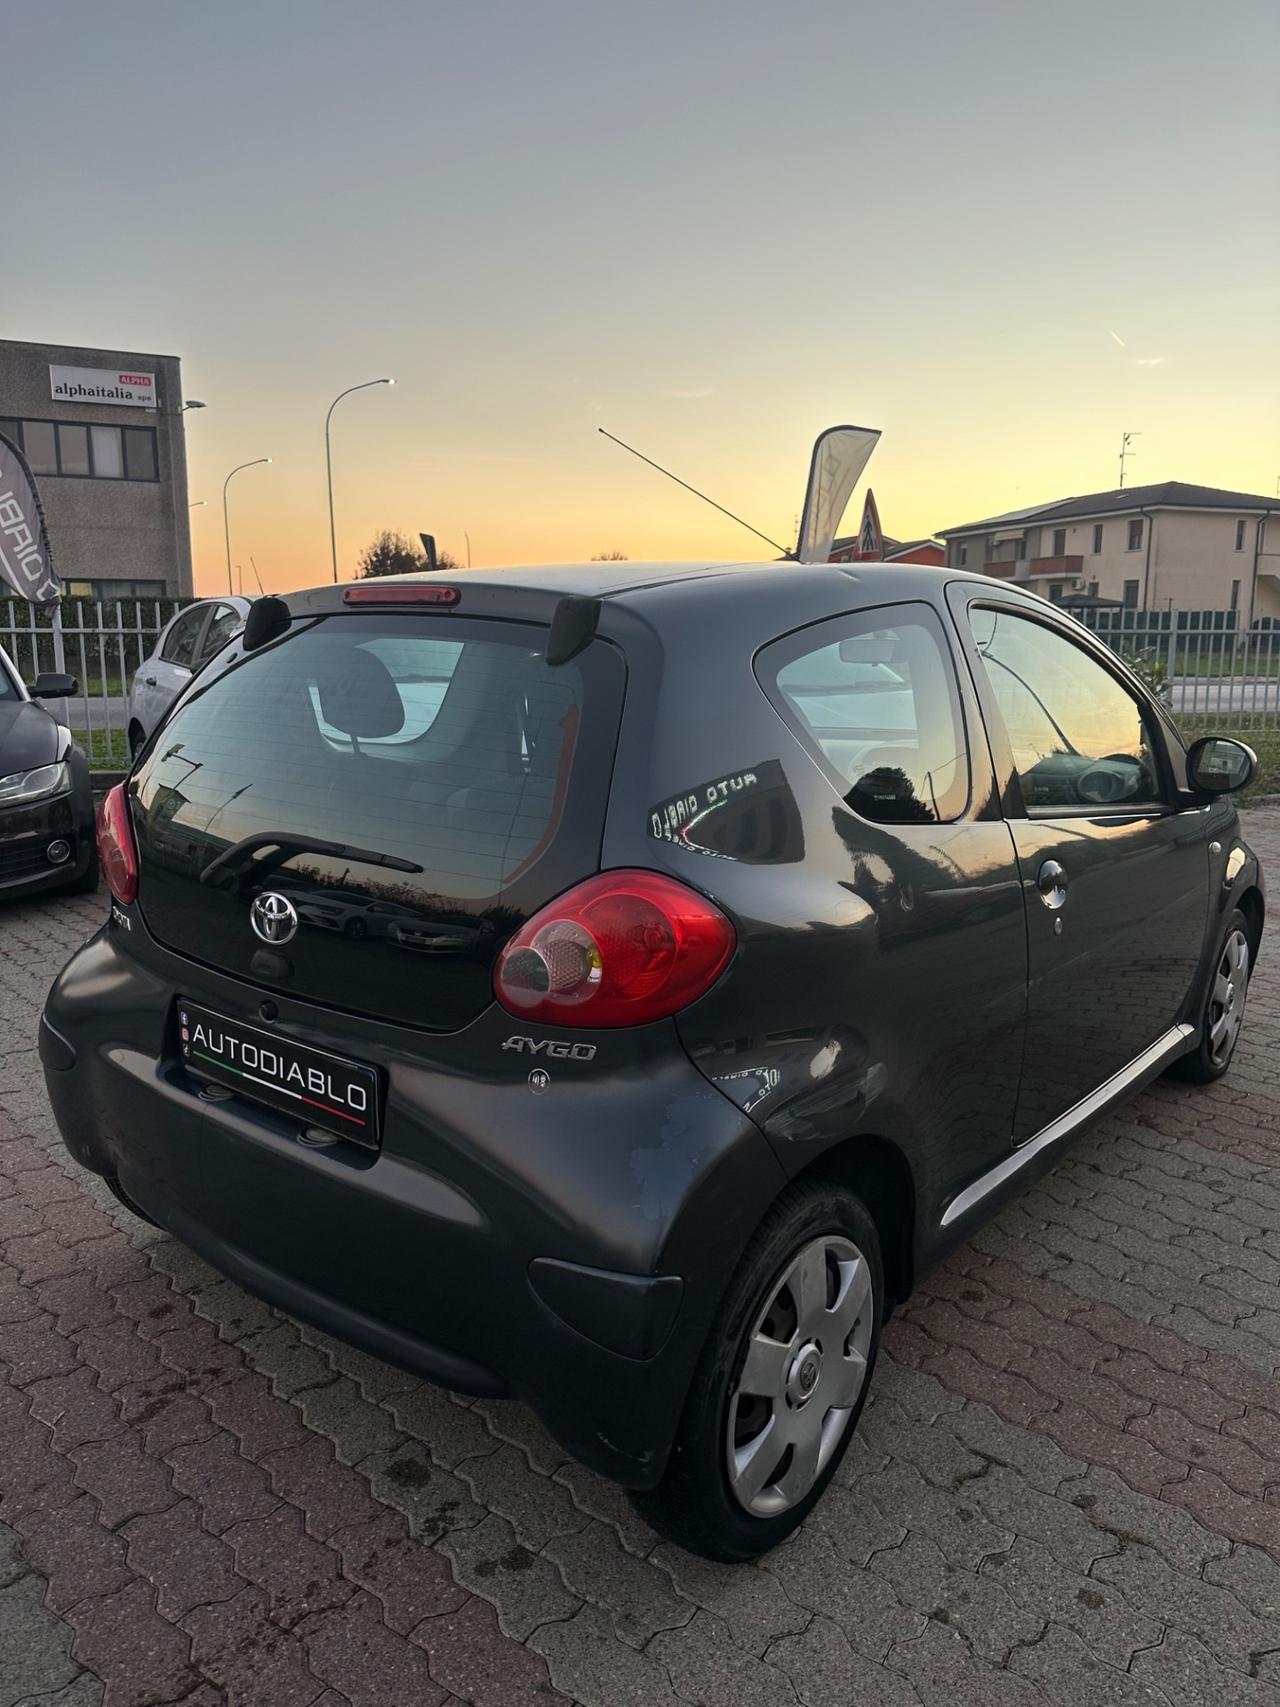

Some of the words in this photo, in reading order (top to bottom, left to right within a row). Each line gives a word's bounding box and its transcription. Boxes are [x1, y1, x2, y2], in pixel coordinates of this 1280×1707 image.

[120, 376, 150, 385] ALPHA
[55, 383, 133, 400] alphaitalia
[501, 1036, 597, 1060] AYGO
[193, 1024, 366, 1111] AUTODIABLO
